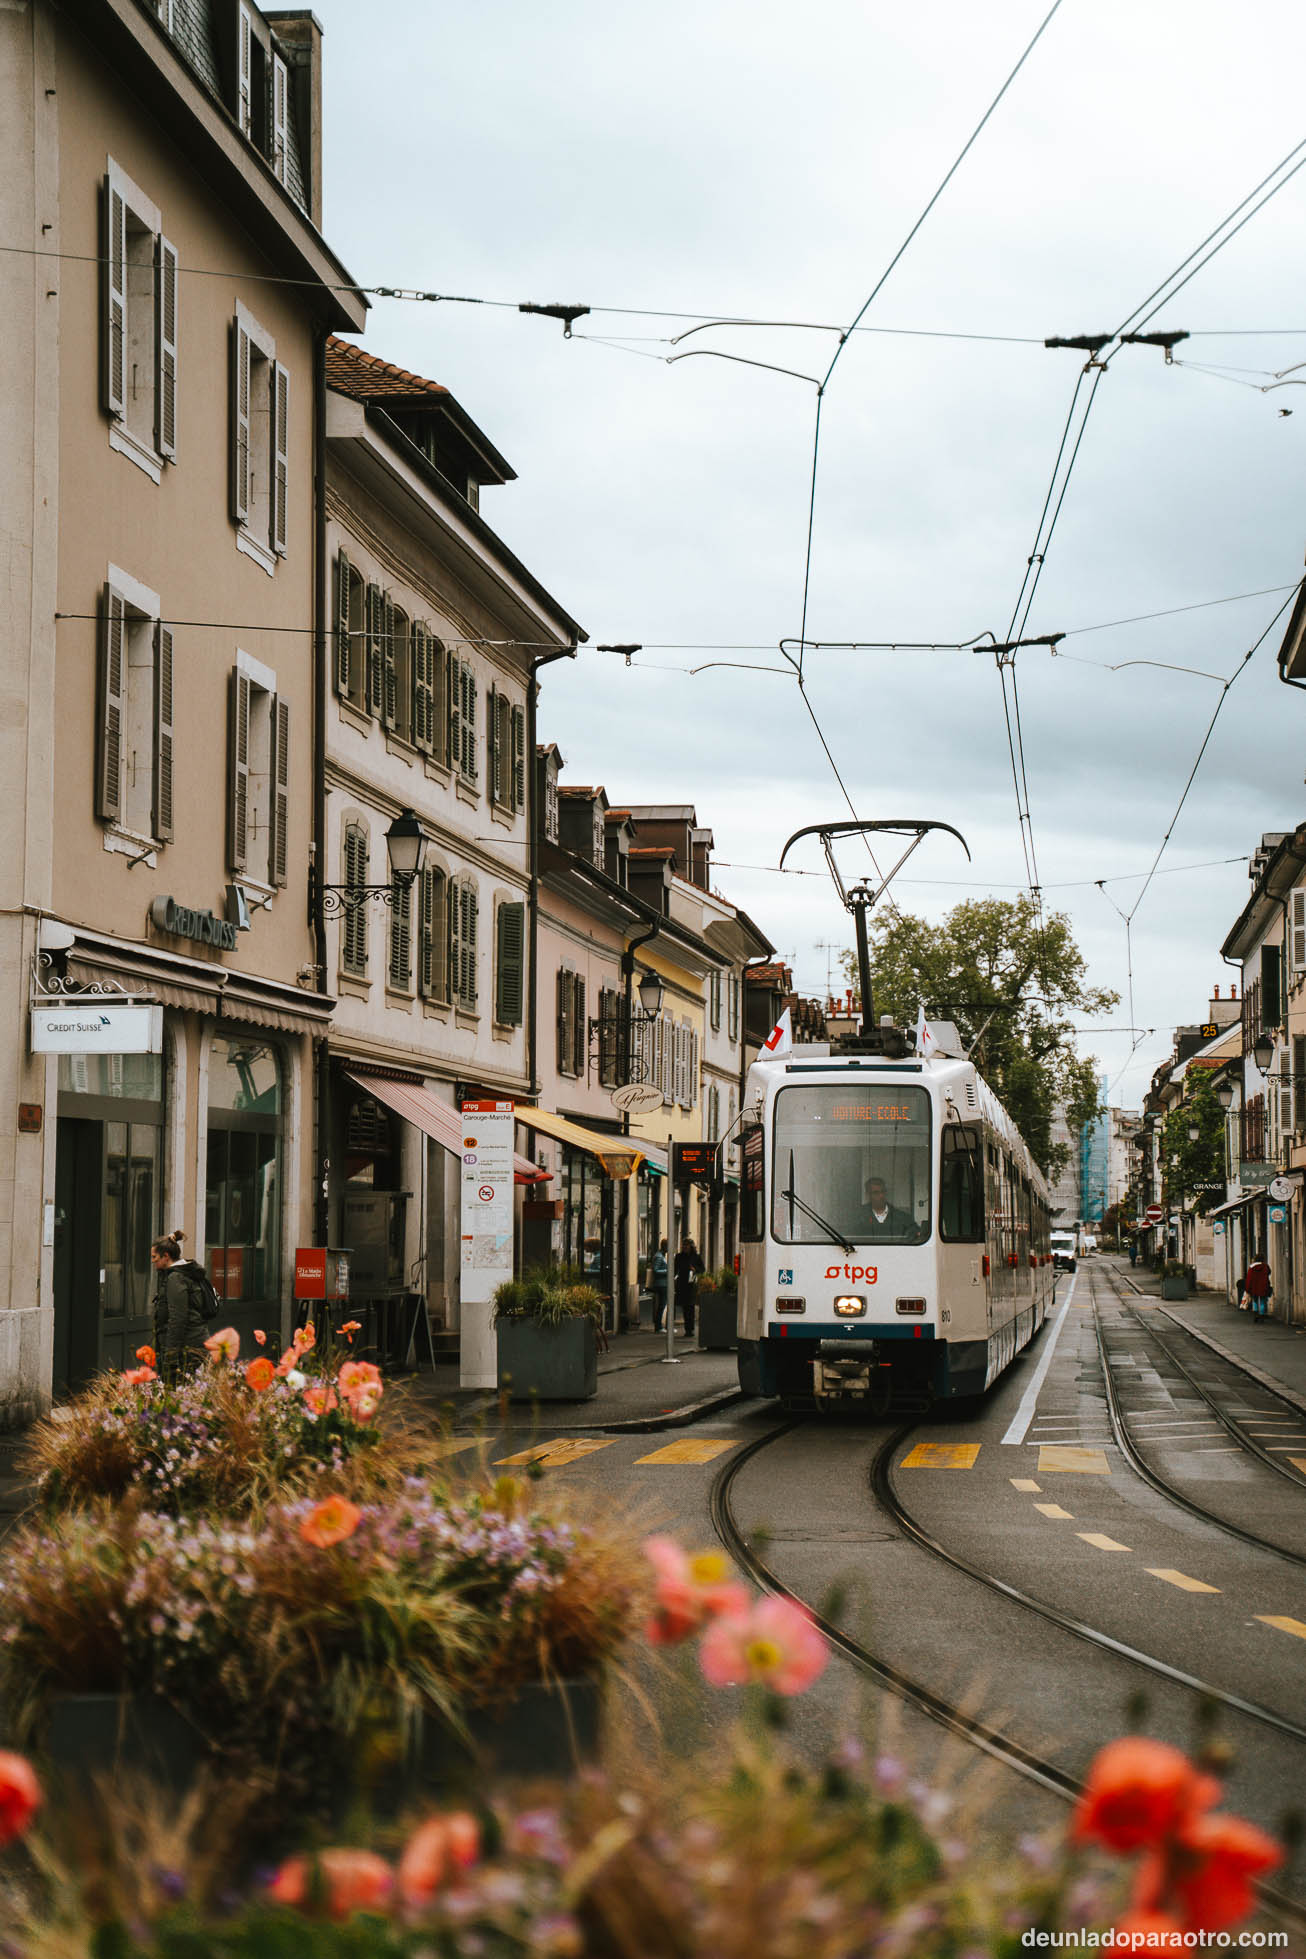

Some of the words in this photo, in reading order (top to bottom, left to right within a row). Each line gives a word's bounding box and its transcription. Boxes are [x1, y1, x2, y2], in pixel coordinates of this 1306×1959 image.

[1202, 1025, 1217, 1037] 25
[466, 1139, 476, 1147] 12
[843, 1263, 878, 1285] tpg
